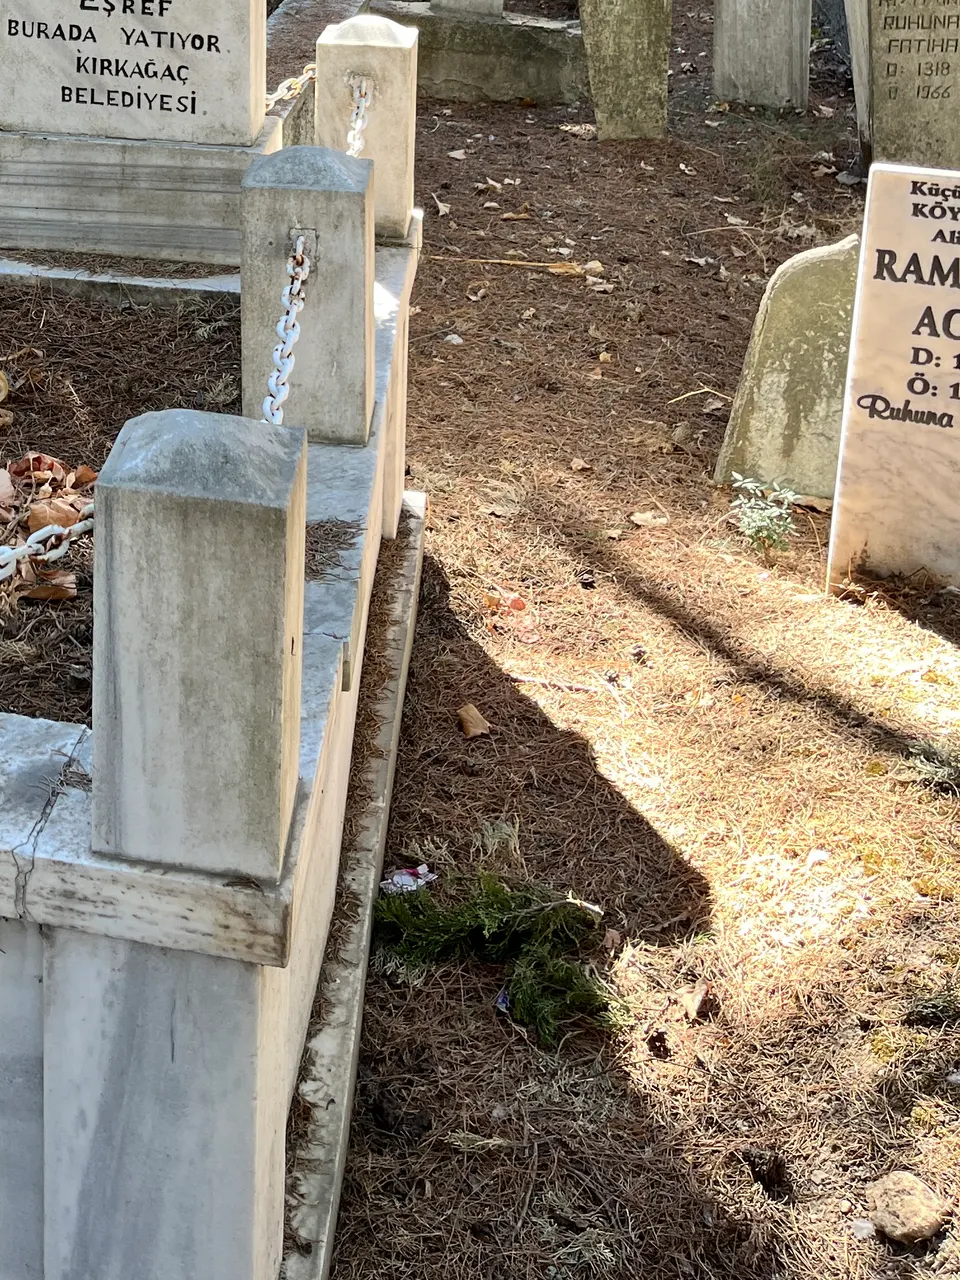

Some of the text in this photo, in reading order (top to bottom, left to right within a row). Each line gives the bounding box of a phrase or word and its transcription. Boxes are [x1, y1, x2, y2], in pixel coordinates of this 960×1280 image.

[7, 19, 97, 43] BURADA
[883, 14, 960, 30] RUHUNA
[76, 56, 189, 85] KIRKAĞAÇ
[918, 61, 951, 77] 1318
[873, 249, 960, 289] RAM
[857, 394, 954, 429] Ruhuna
